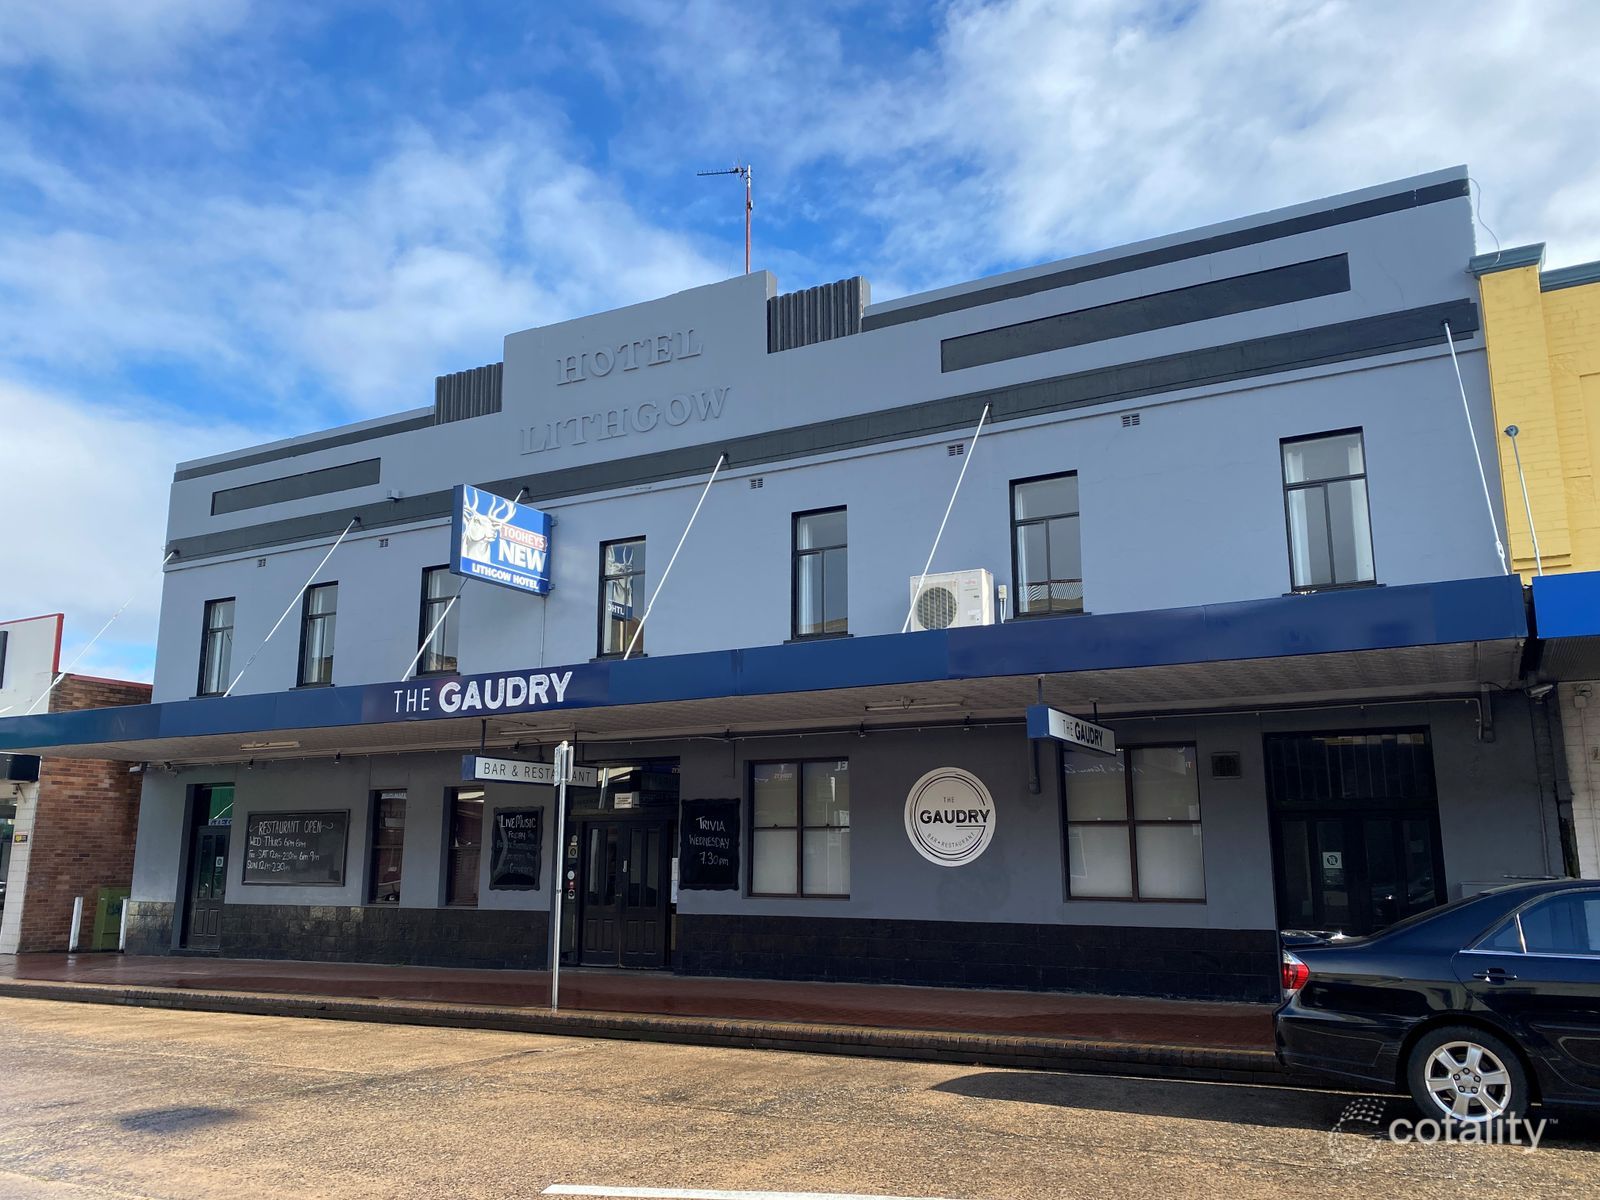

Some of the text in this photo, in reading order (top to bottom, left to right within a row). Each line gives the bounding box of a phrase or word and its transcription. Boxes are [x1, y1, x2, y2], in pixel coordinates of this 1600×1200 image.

[556, 328, 703, 386] HOTEL
[520, 385, 730, 455] LITHGOW
[502, 526, 544, 548] TOOHEYS
[498, 538, 547, 573] NEW
[472, 563, 539, 589] LITHGOW HOTEL
[394, 671, 573, 713] THE GAUDRY
[1062, 719, 1104, 748] THE GAUDRY
[483, 762, 506, 776] BAR
[511, 765, 518, 777] &
[943, 796, 955, 804] THE
[695, 815, 726, 832] TRIVIA
[920, 809, 991, 824] GAUDRY
[258, 820, 321, 835] RESTAURANT OPEN
[249, 836, 261, 847] WED
[688, 833, 730, 849] WEDNESDAY
